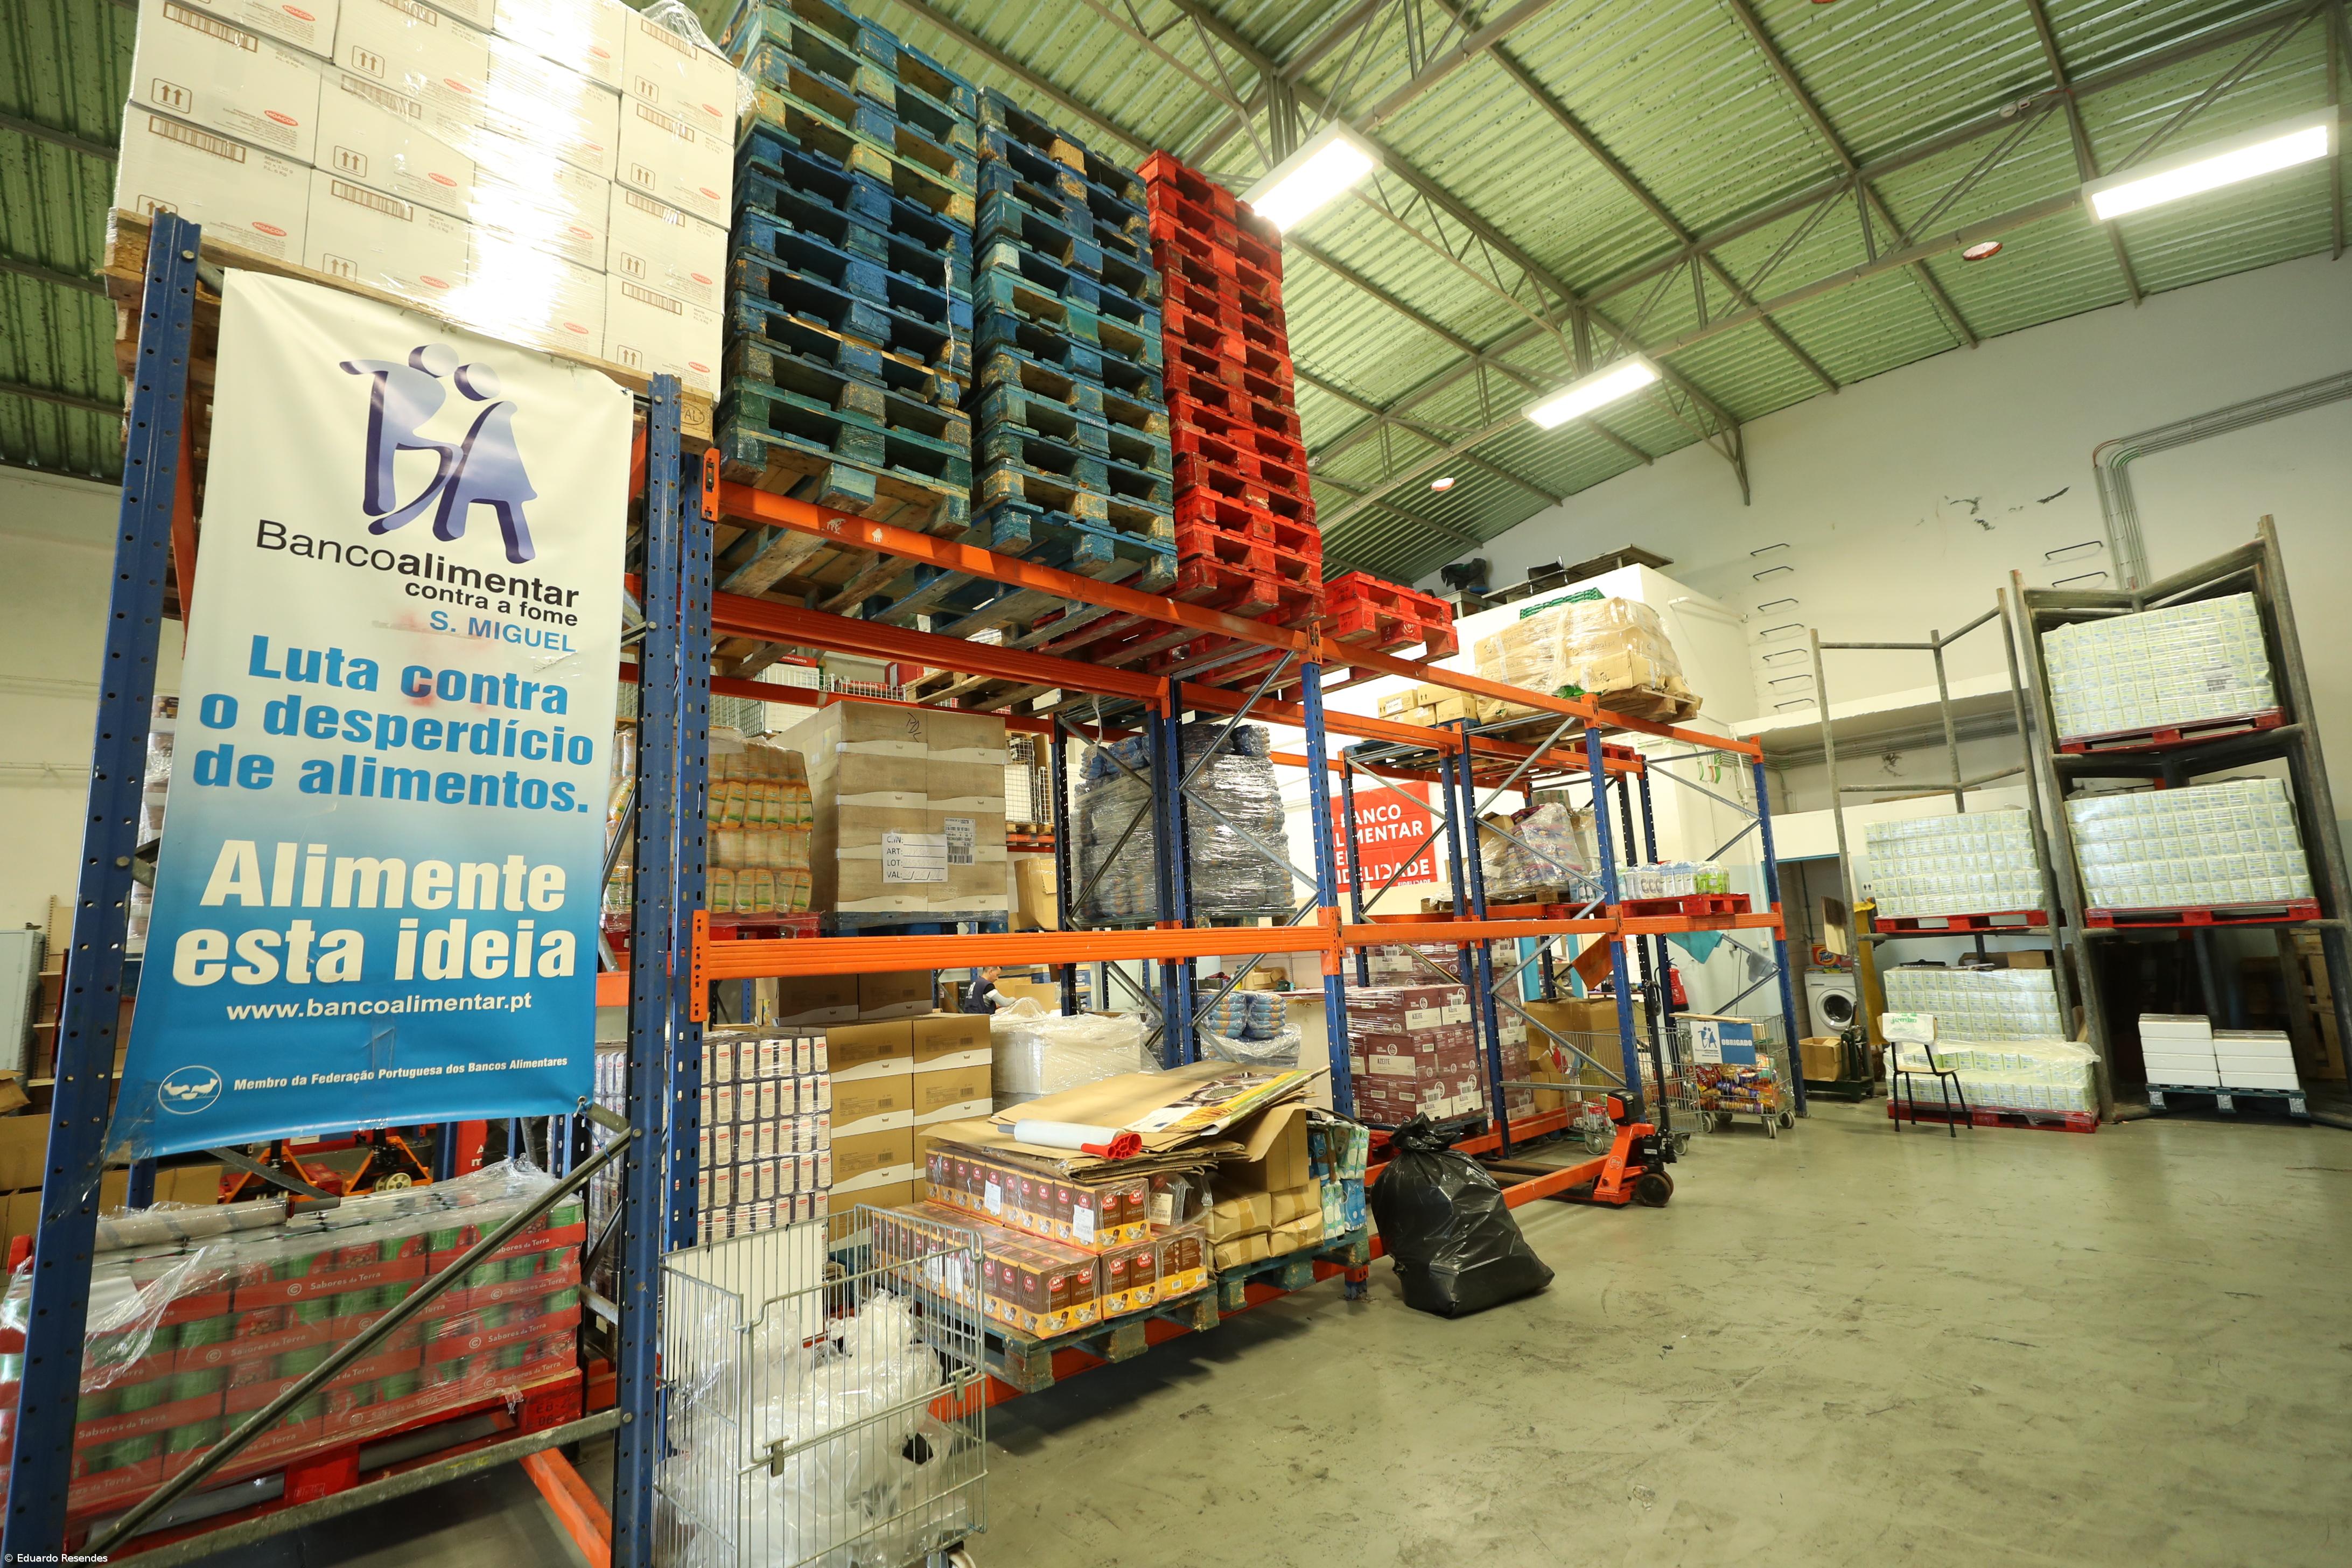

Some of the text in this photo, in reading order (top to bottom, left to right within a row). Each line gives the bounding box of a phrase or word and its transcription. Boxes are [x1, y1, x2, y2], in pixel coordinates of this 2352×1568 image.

[255, 519, 580, 608] Bancoalimentar
[404, 580, 579, 627] contra a fome
[429, 610, 577, 653] S. MIGUEL
[248, 634, 569, 716] Luta contra
[199, 692, 594, 766] o desperdício
[192, 744, 589, 814] de alimentos.
[199, 839, 566, 912] Alimente
[172, 918, 576, 987] esta ideia
[226, 991, 533, 1021] www.bancoalimentar.pt
[1721, 1039, 1753, 1047] OBRIGADO
[234, 1056, 568, 1091] Membro da Federação Portuguesa dos Bancos Alimentares
[531, 1237, 550, 1247] Terra
[310, 1278, 347, 1290] Sabores
[359, 1271, 381, 1282] Terra
[547, 1277, 566, 1287] Terra
[424, 1304, 445, 1314] Terra
[282, 1334, 306, 1345] Terra
[488, 1331, 519, 1343] Sabores
[528, 1322, 547, 1333] Terra
[352, 1364, 375, 1377] Terra
[541, 1361, 561, 1373] Terra
[78, 1413, 166, 1439] Sabores da Terra
[271, 1432, 297, 1445] Terra
[103, 1475, 132, 1488] Terra
